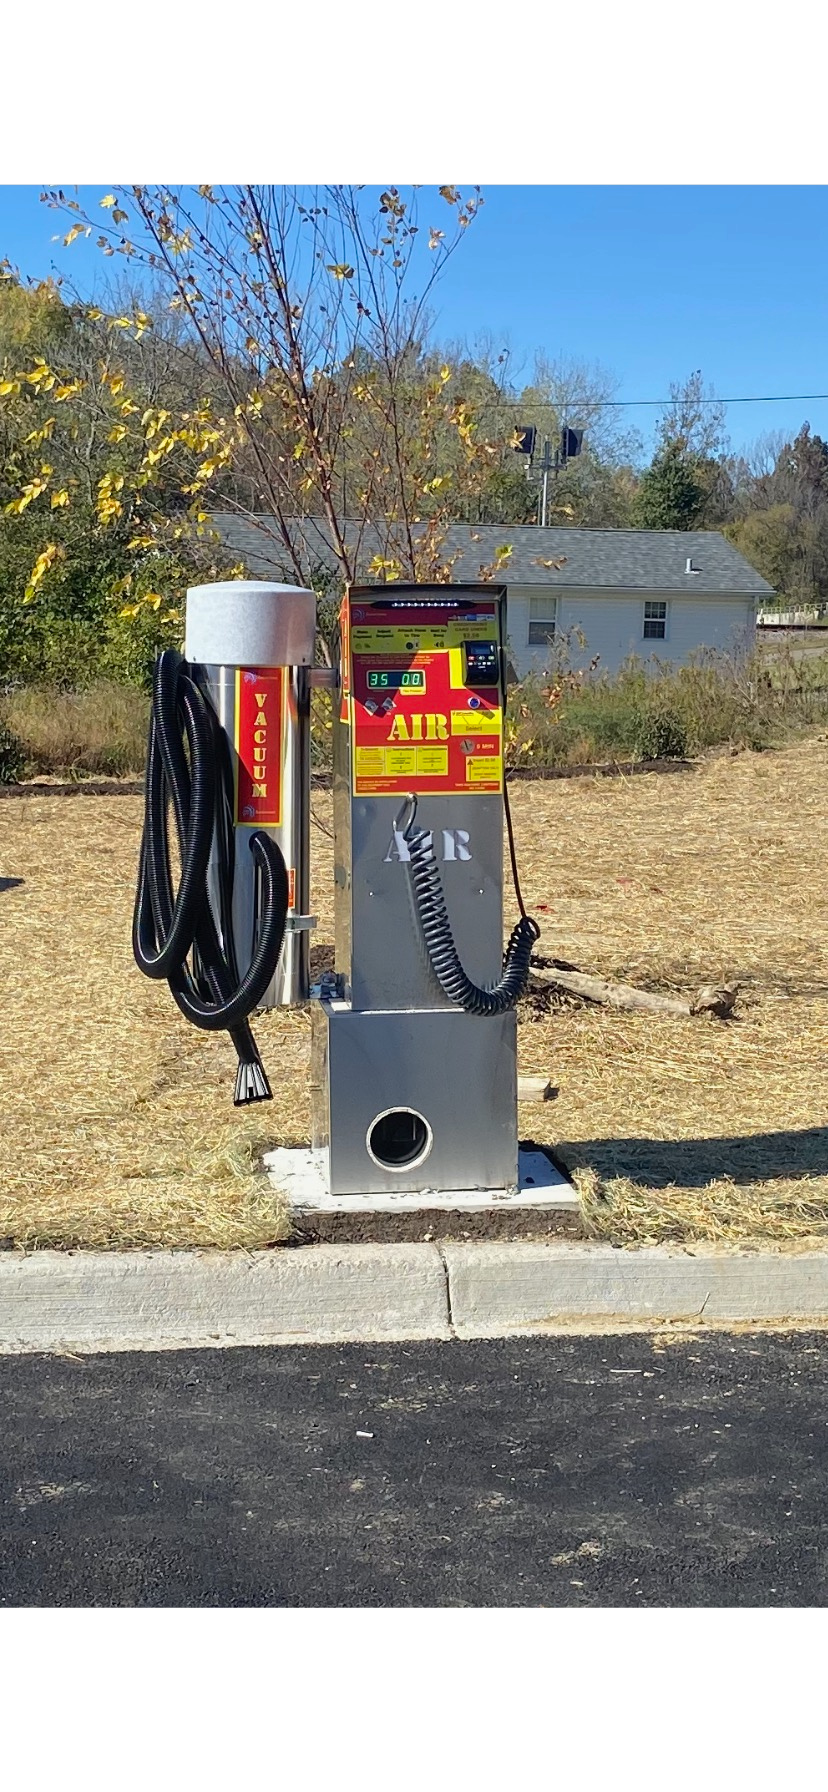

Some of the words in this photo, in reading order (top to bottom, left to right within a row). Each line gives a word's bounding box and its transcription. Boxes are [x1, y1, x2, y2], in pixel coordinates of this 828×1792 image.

[370, 673, 388, 685] 35
[386, 713, 450, 741] AIR
[251, 693, 268, 798] VACUUM
